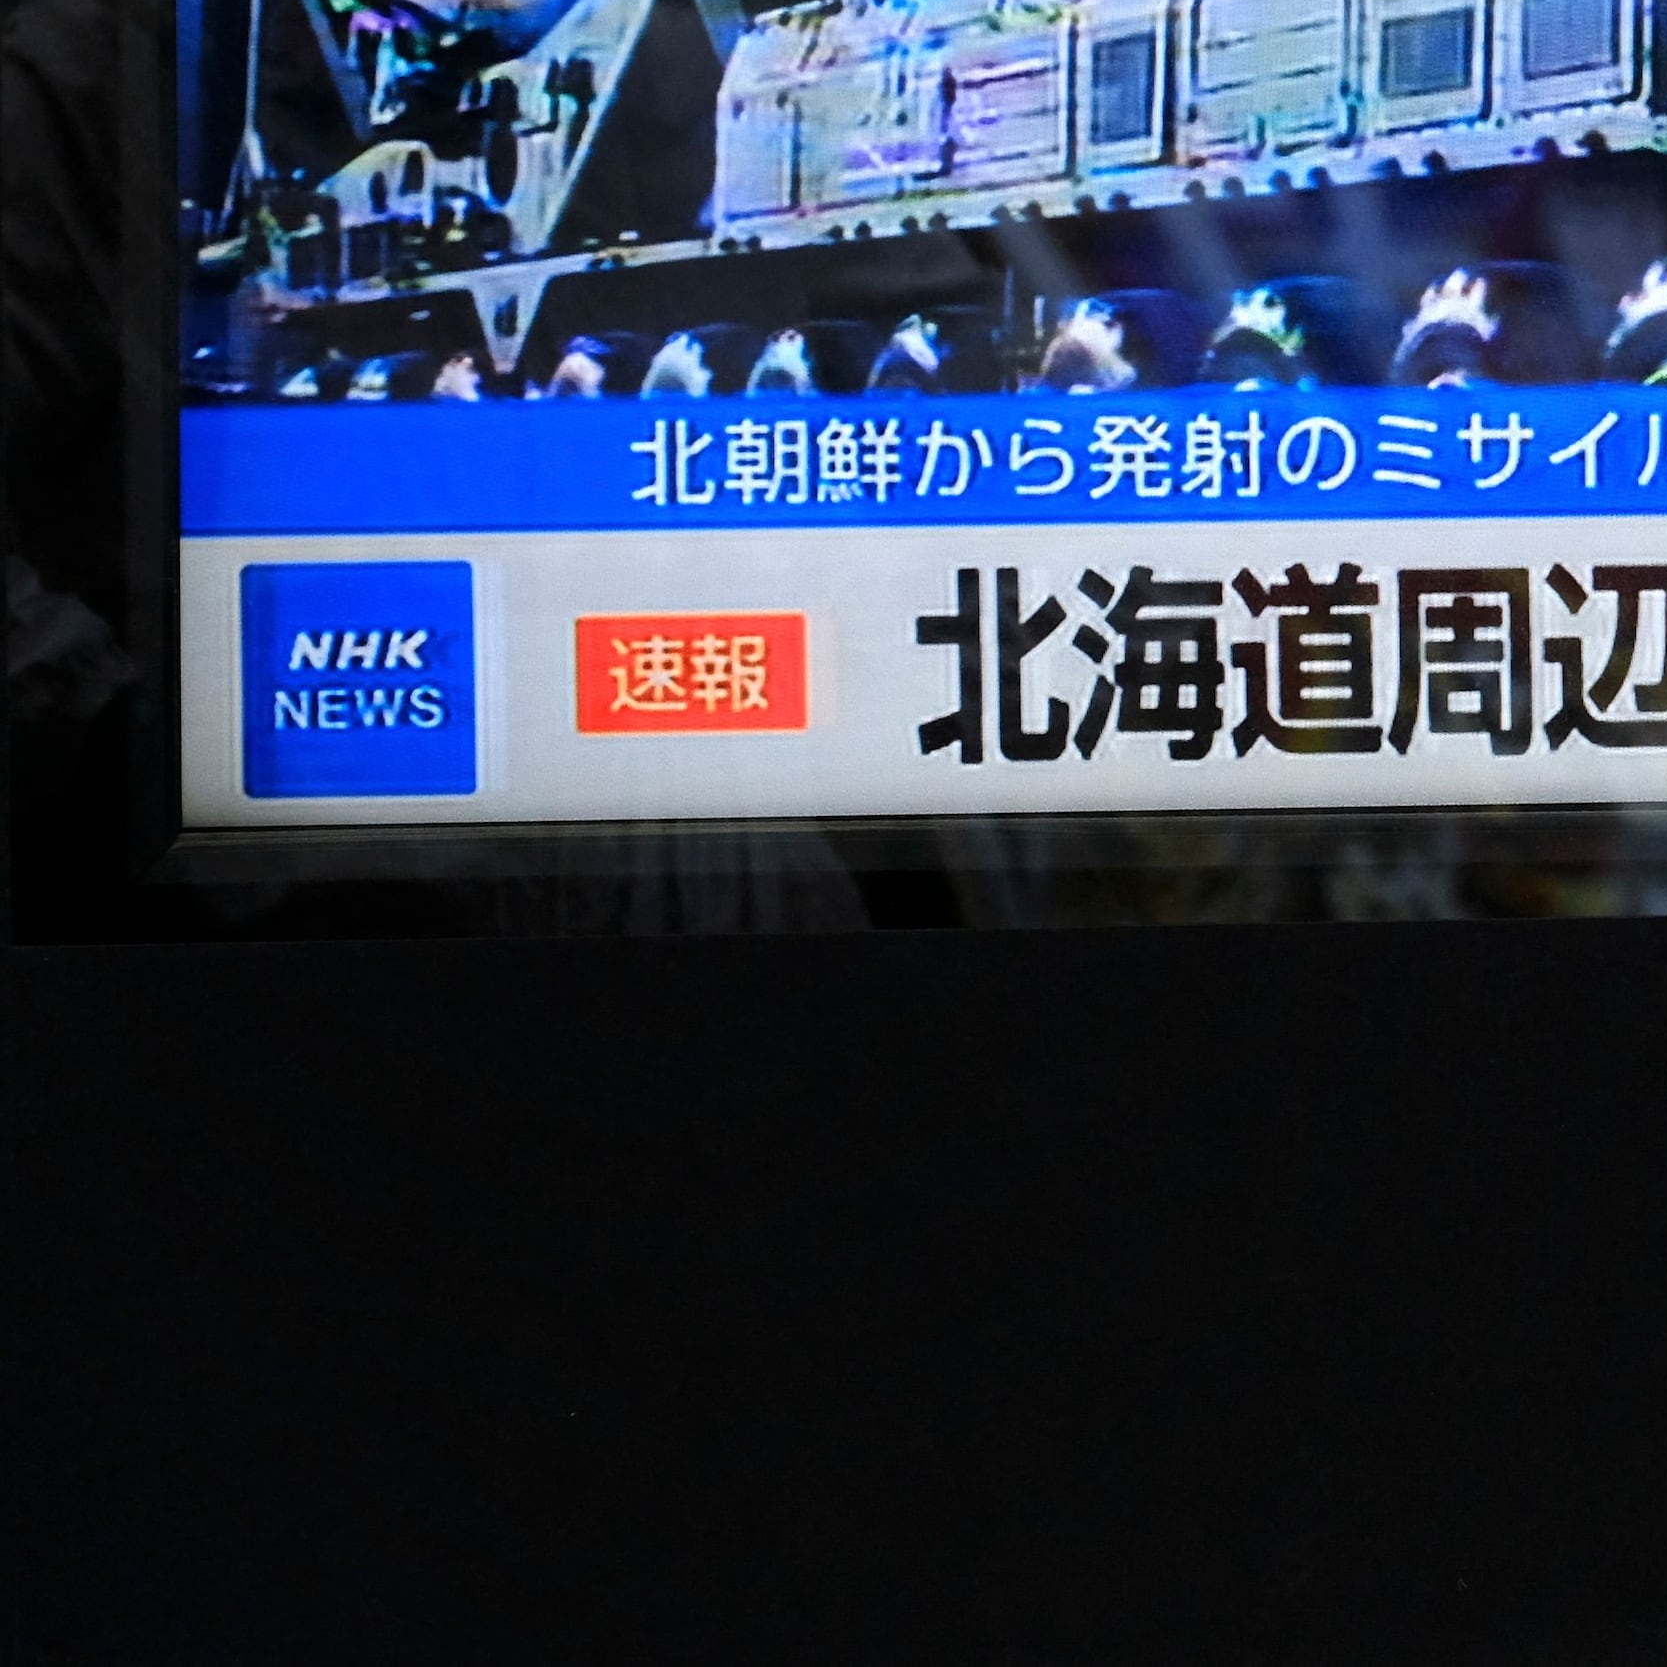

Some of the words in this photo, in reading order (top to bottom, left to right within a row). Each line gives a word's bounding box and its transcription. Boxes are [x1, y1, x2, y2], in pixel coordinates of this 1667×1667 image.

[289, 631, 429, 671] NHK
[609, 635, 769, 712] 速報
[273, 686, 444, 730] NEWS
